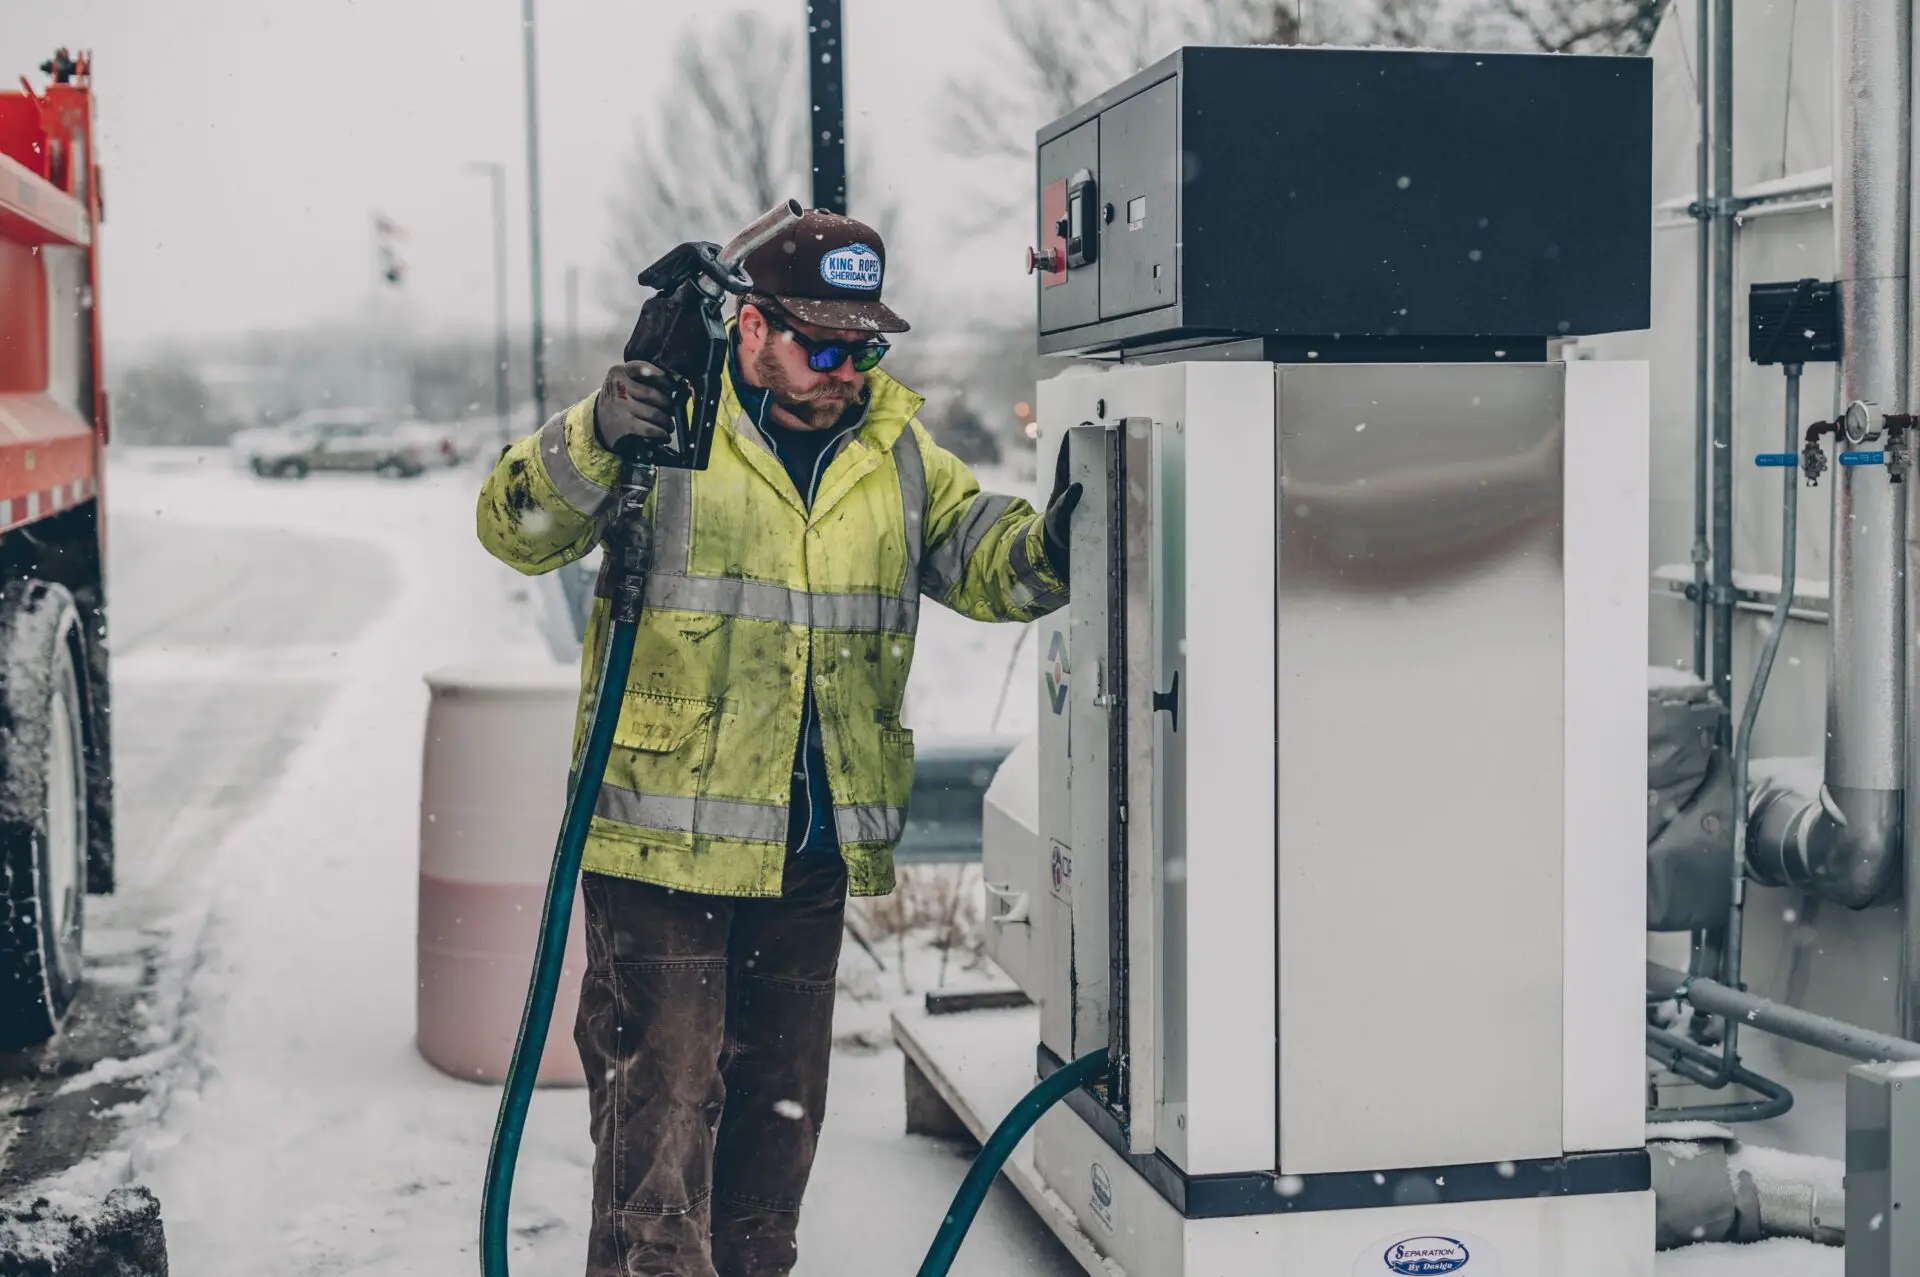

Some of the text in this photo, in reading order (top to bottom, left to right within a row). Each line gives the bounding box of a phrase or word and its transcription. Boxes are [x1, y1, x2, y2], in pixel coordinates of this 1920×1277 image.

[829, 257, 853, 270] KING
[1395, 1245, 1454, 1259] SEPARATION
[1423, 1262, 1453, 1270] Design
